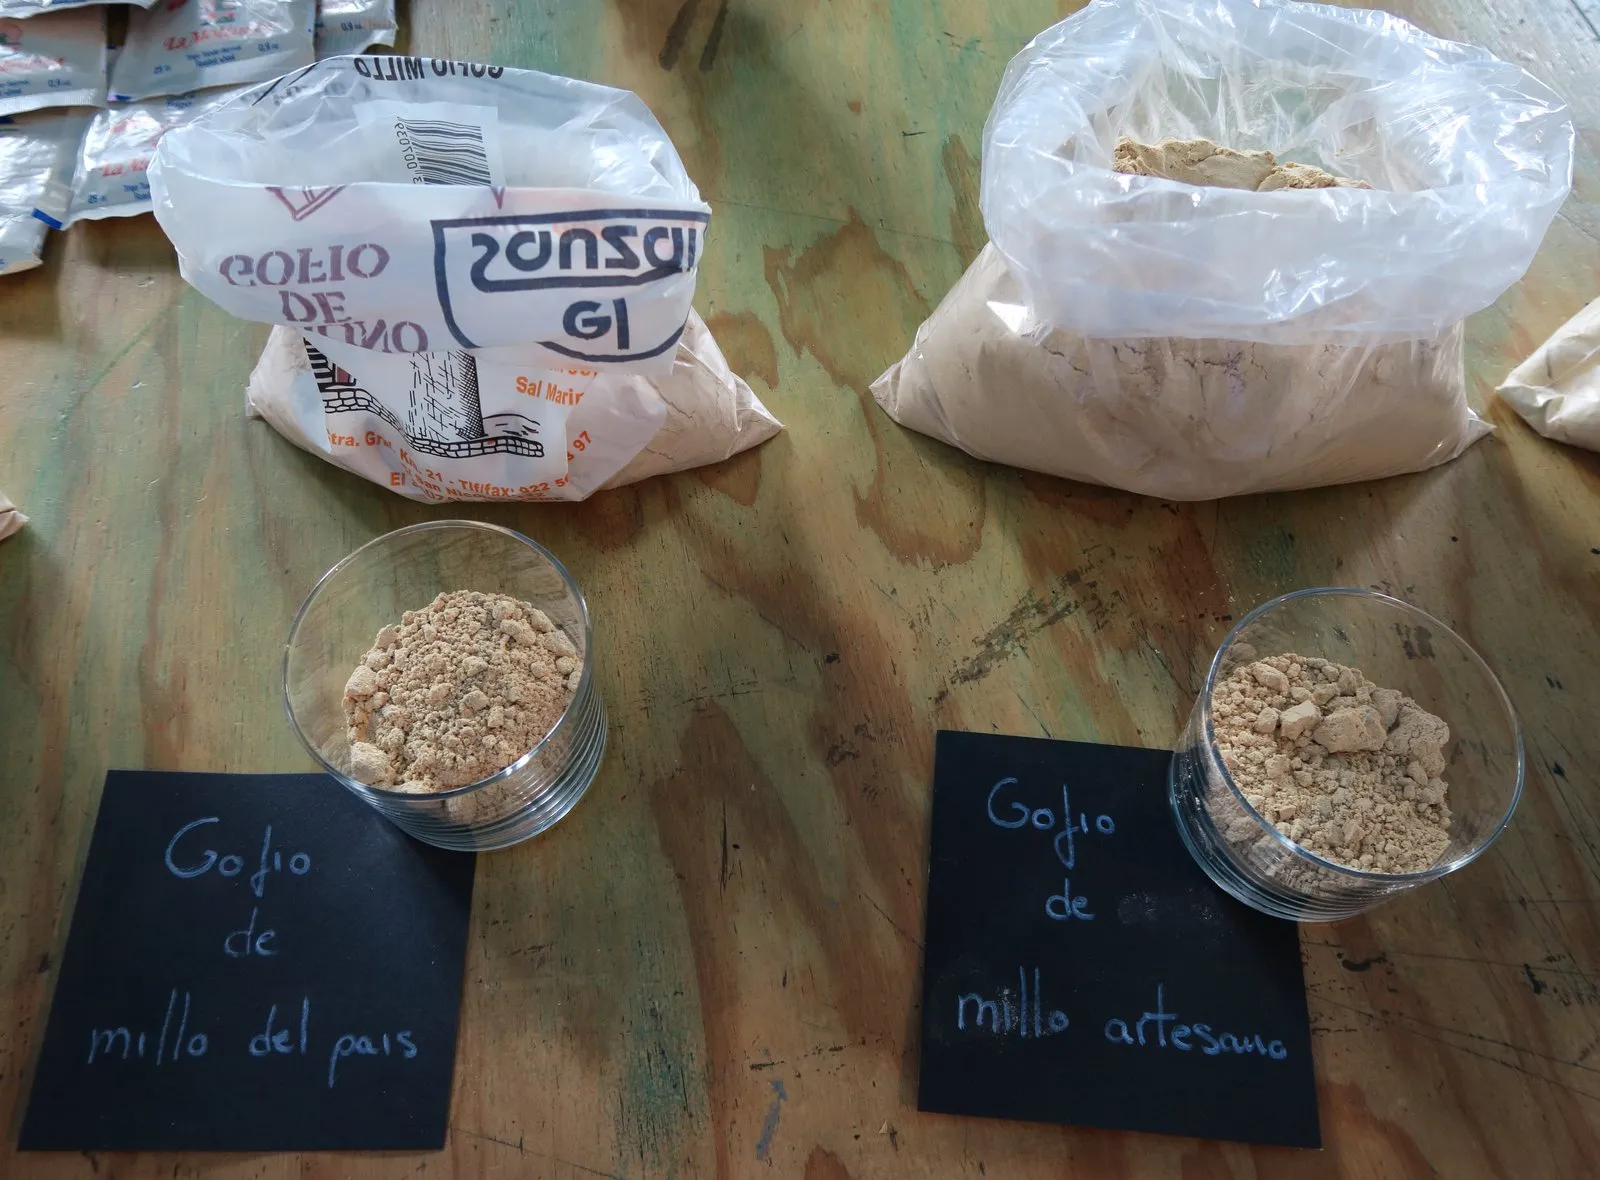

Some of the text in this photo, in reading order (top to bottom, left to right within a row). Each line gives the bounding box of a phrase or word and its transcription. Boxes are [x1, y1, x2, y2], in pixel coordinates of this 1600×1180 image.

[515, 375, 543, 398] Sal
[328, 431, 360, 447] tra.
[425, 469, 443, 482] 21
[987, 777, 1115, 870] Gofio
[164, 816, 311, 898] Gofio
[224, 907, 277, 957] de
[1045, 878, 1095, 921] de
[87, 988, 418, 1089] millo del pais
[957, 965, 1288, 1060] millo artesano
